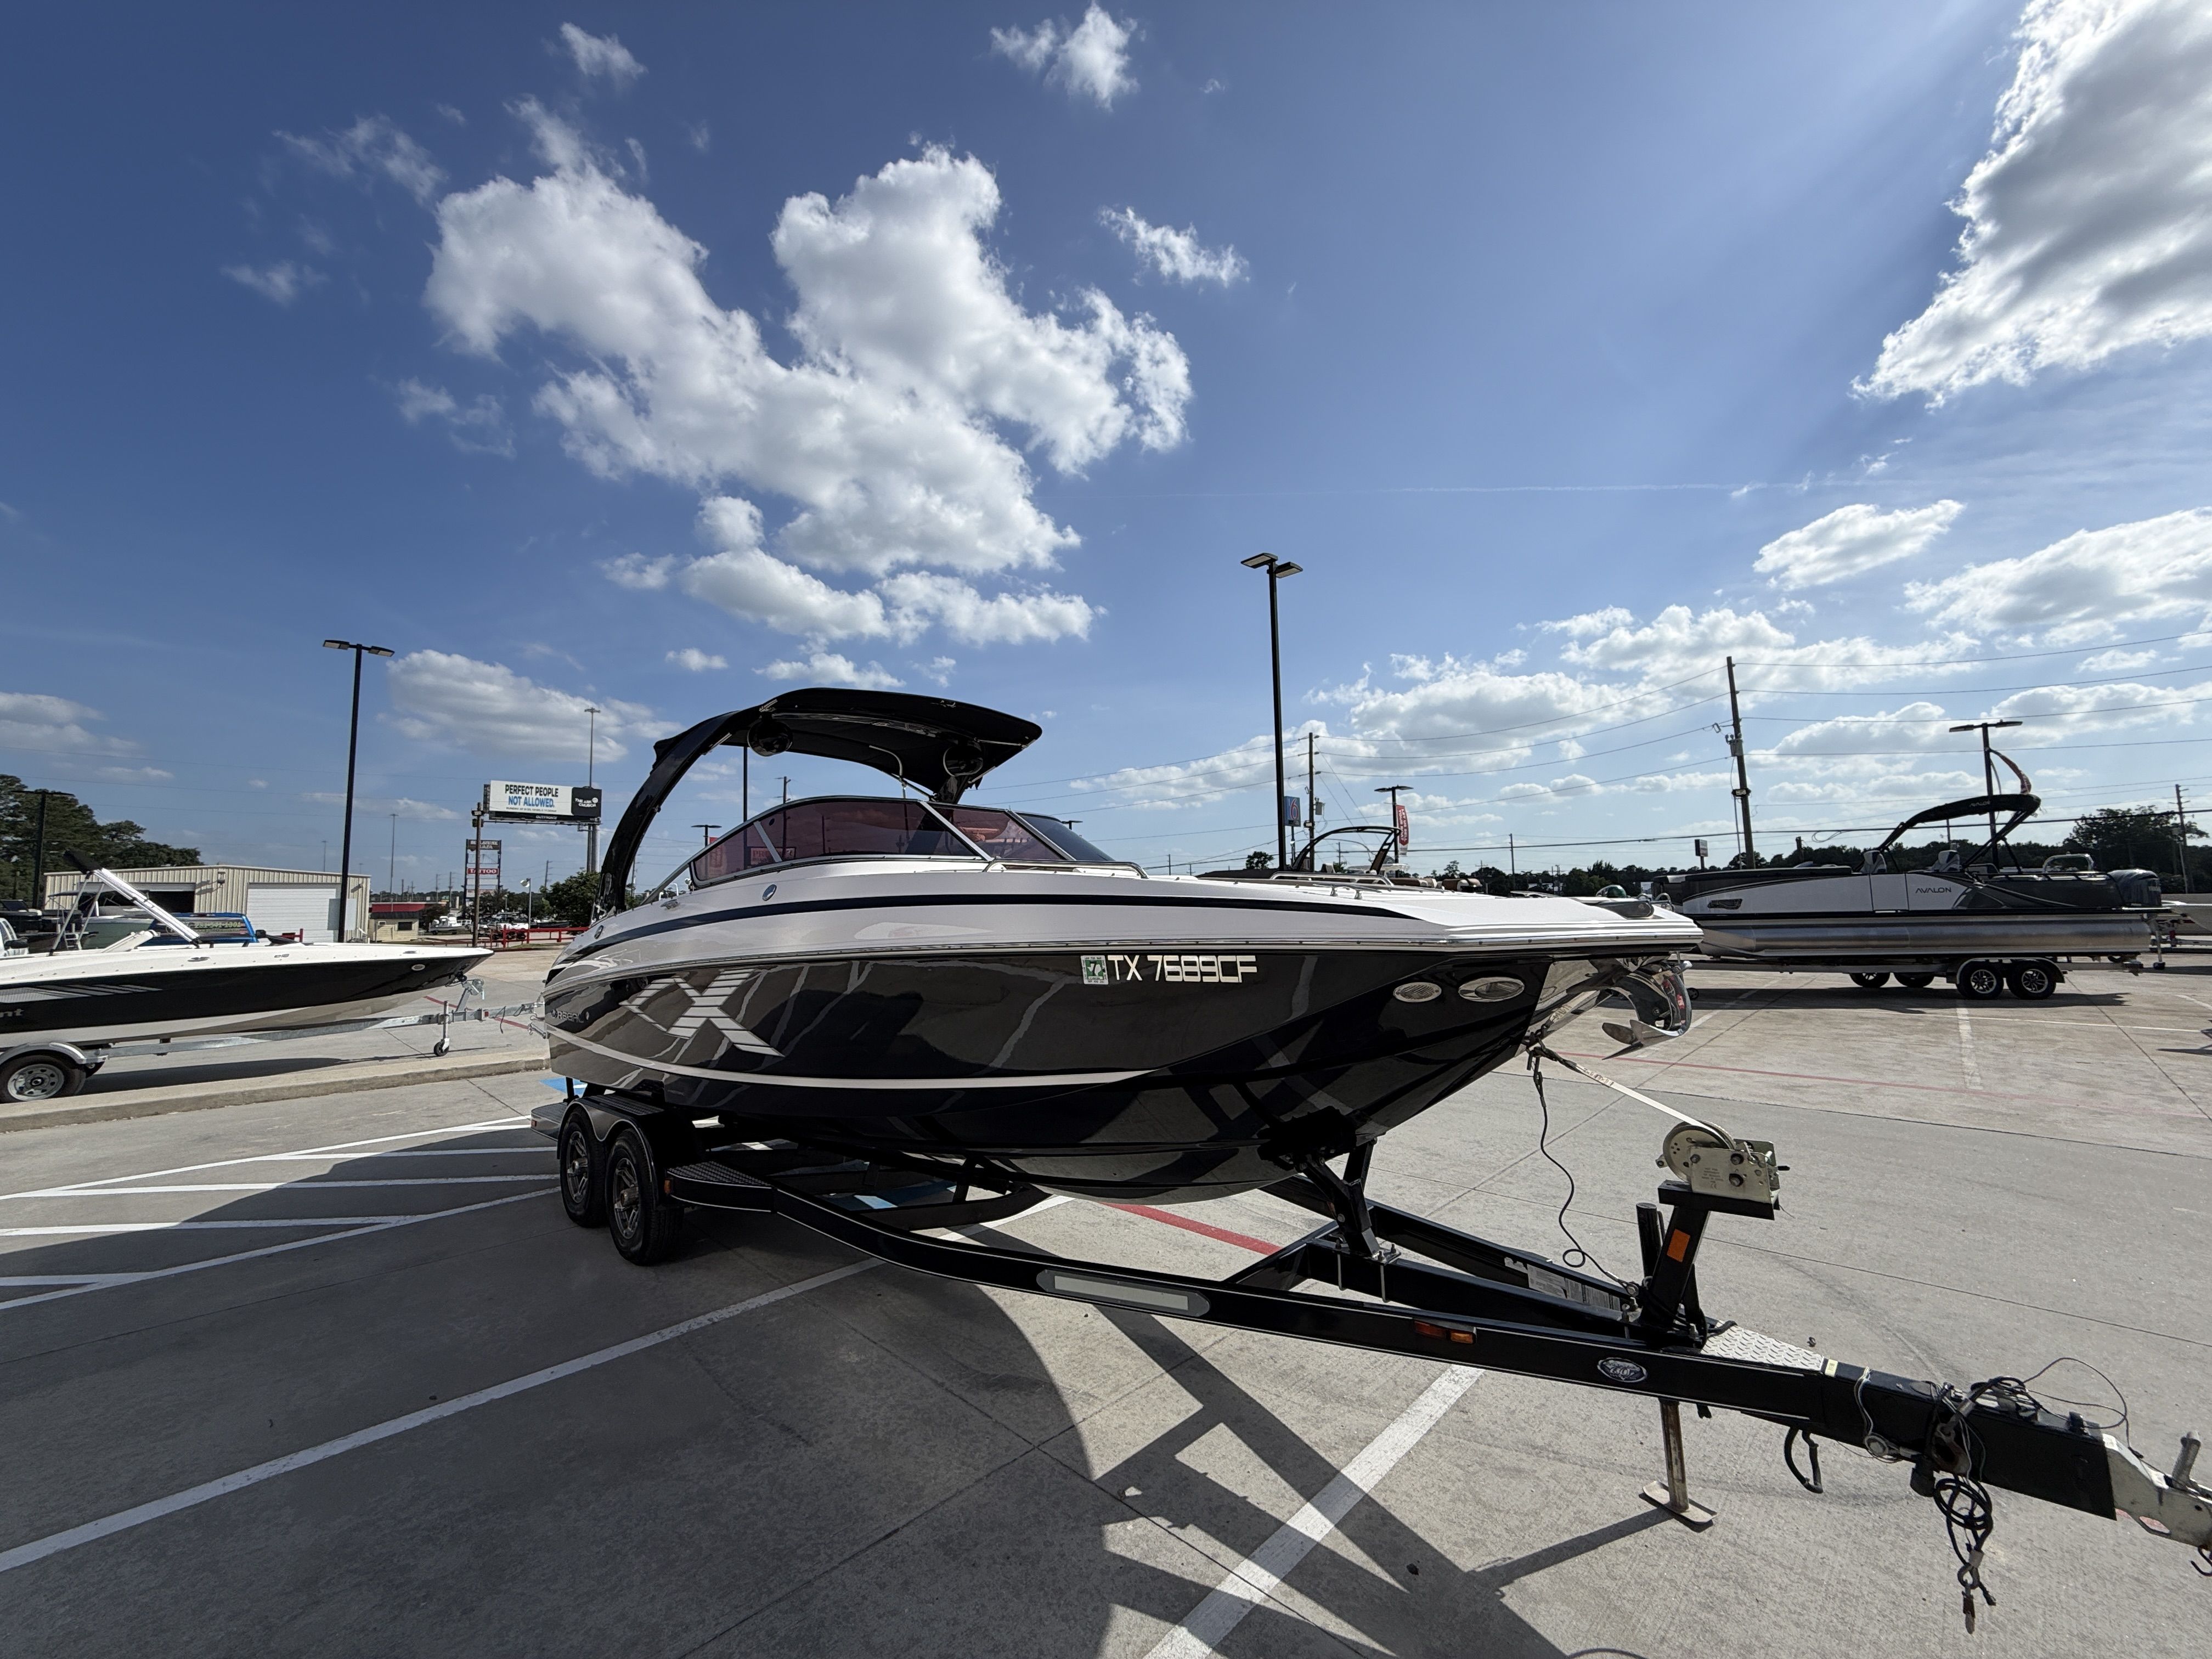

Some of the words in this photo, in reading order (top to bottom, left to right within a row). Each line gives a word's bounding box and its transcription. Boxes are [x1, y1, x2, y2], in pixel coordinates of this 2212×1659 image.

[505, 784, 533, 795] PERFECT
[535, 786, 558, 797] PEOPLE
[508, 795, 522, 805] NOT
[523, 797, 555, 808] ALLOWED.
[1290, 798, 1299, 820] 6
[1107, 955, 1143, 980] TX
[1147, 955, 1257, 983] 7689CF
[557, 1011, 584, 1024] REGAL
